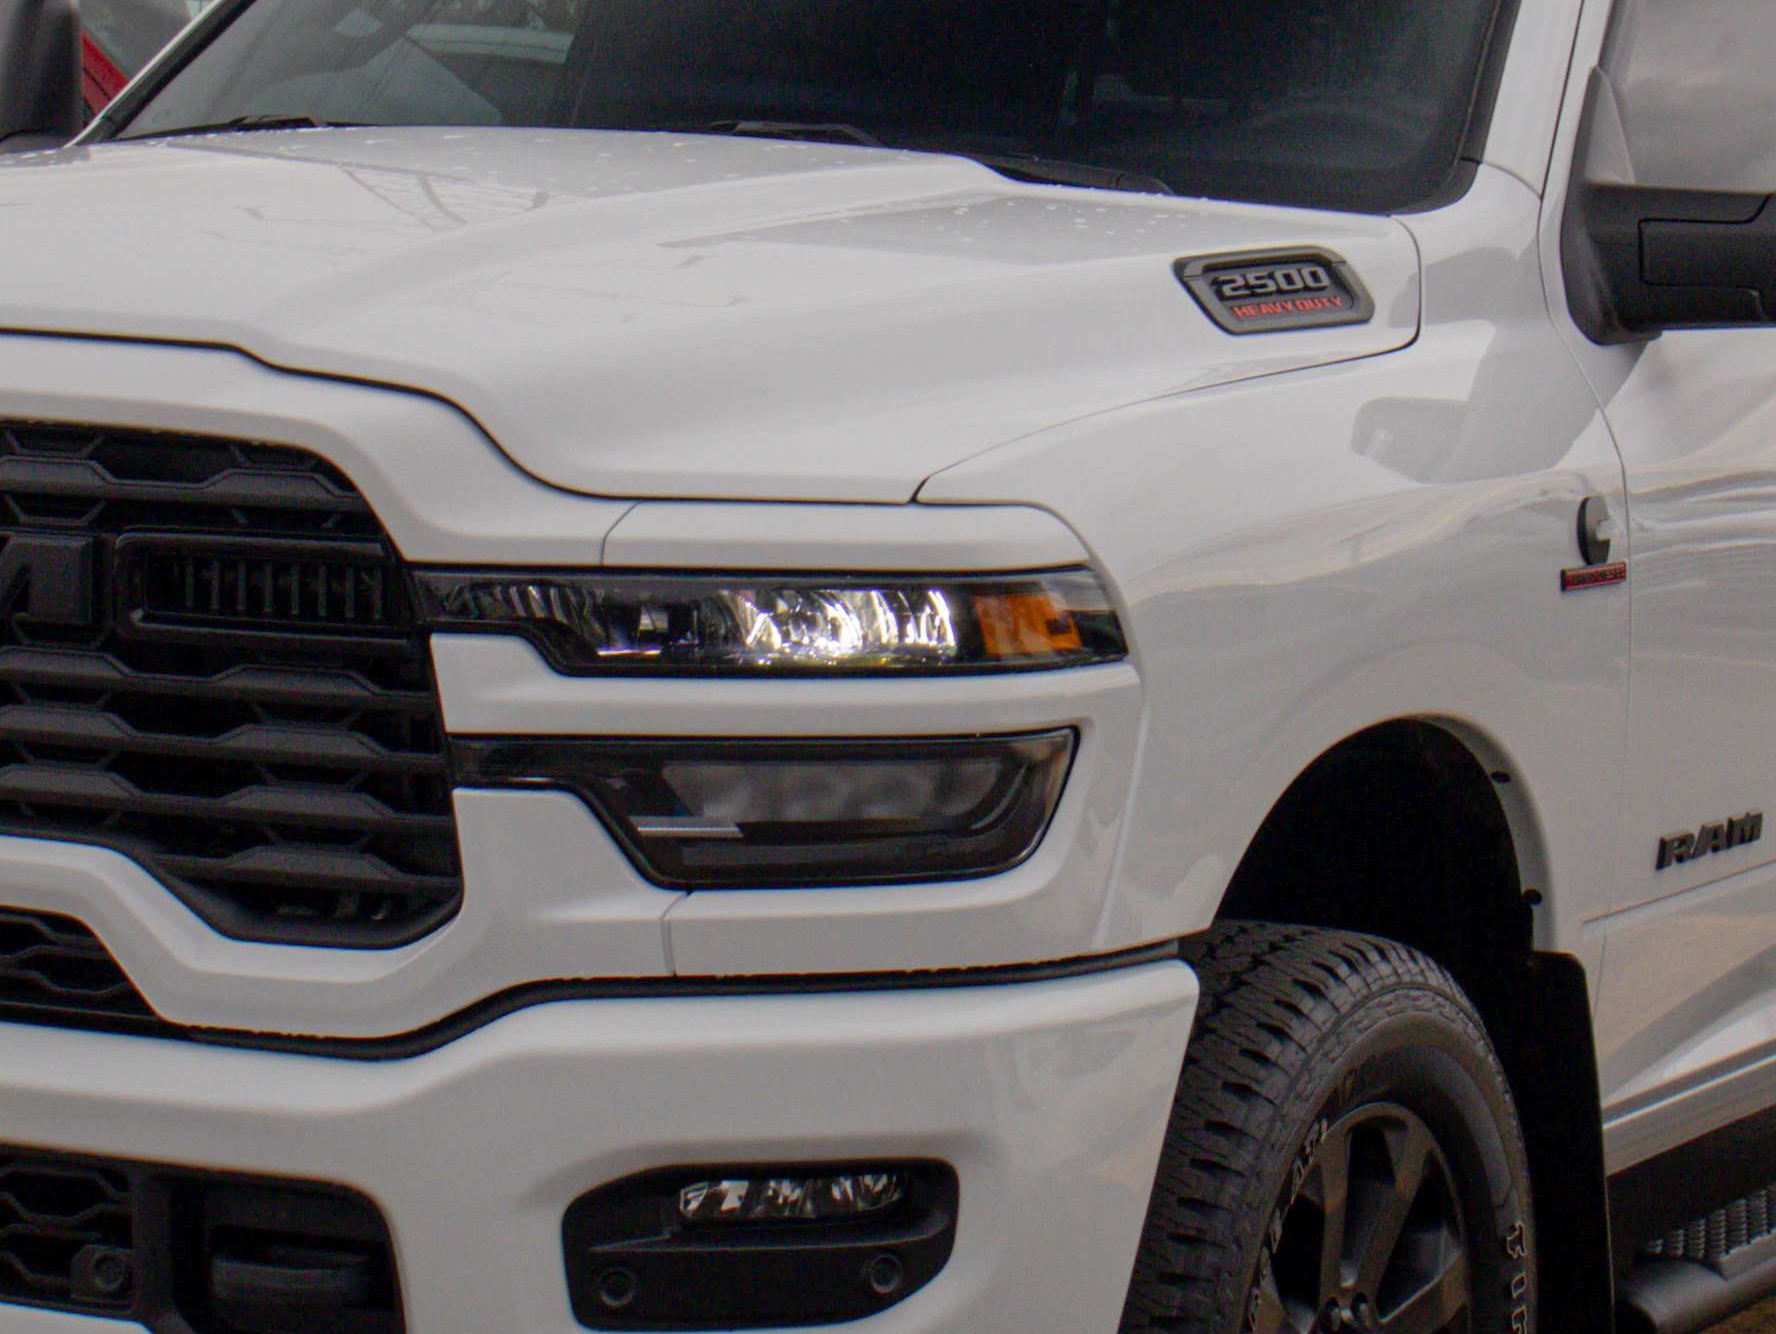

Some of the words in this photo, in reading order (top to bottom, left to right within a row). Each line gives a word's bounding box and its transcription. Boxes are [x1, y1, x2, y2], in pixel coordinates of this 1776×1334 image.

[1213, 266, 1330, 299] 2500
[1233, 300, 1293, 320] HEAVY
[1295, 296, 1342, 313] DUTY
[1655, 810, 1763, 870] RAM
